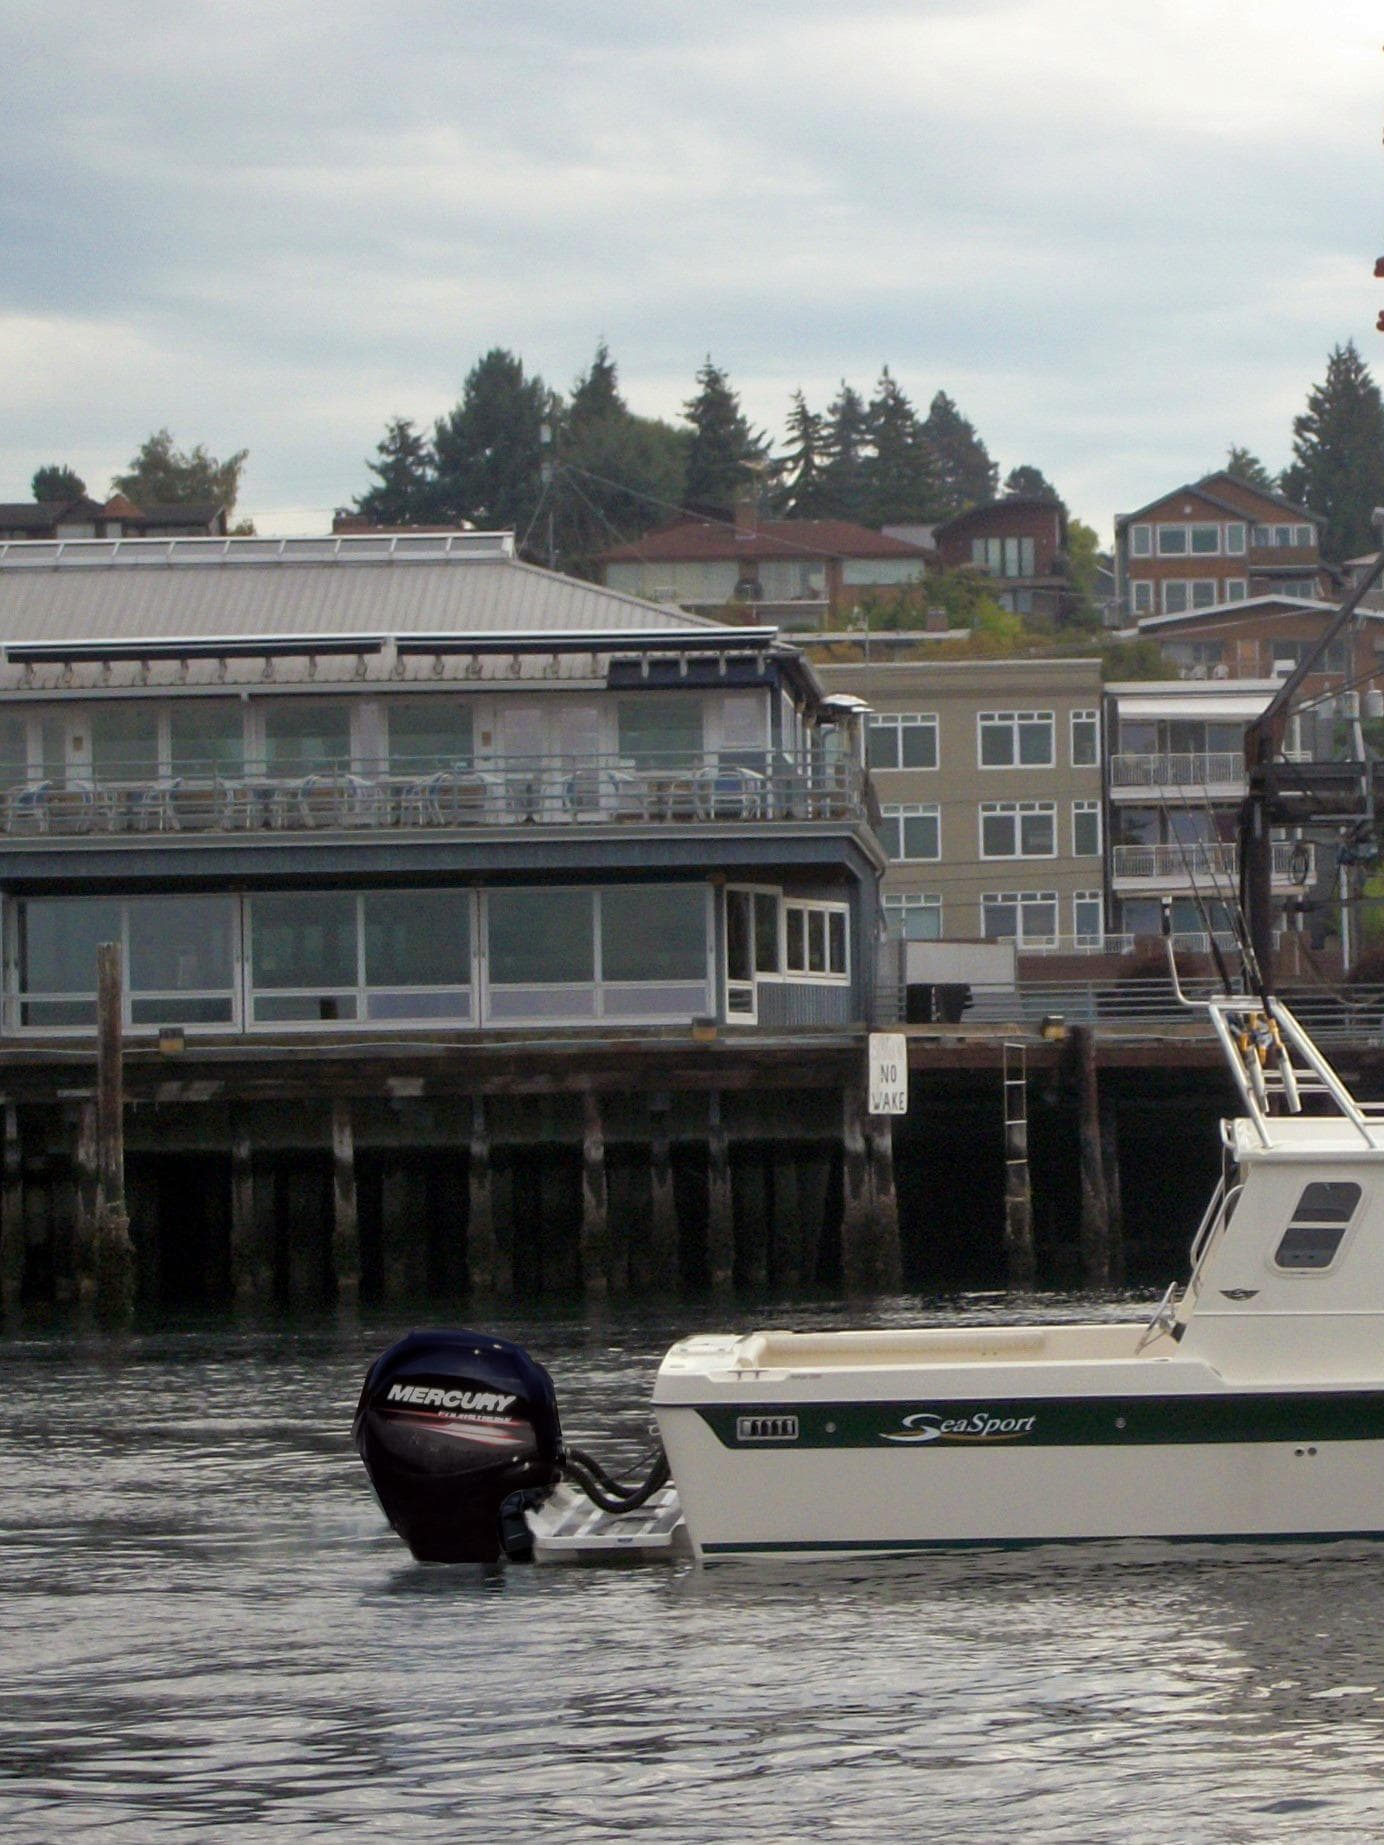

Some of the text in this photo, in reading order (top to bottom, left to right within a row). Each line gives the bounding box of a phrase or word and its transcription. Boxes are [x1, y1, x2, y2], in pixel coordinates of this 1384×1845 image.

[880, 1064, 897, 1084] NO
[871, 1091, 905, 1111] WAKE
[387, 1383, 517, 1412] MERCURY
[878, 1412, 1037, 1442] SeaSport
